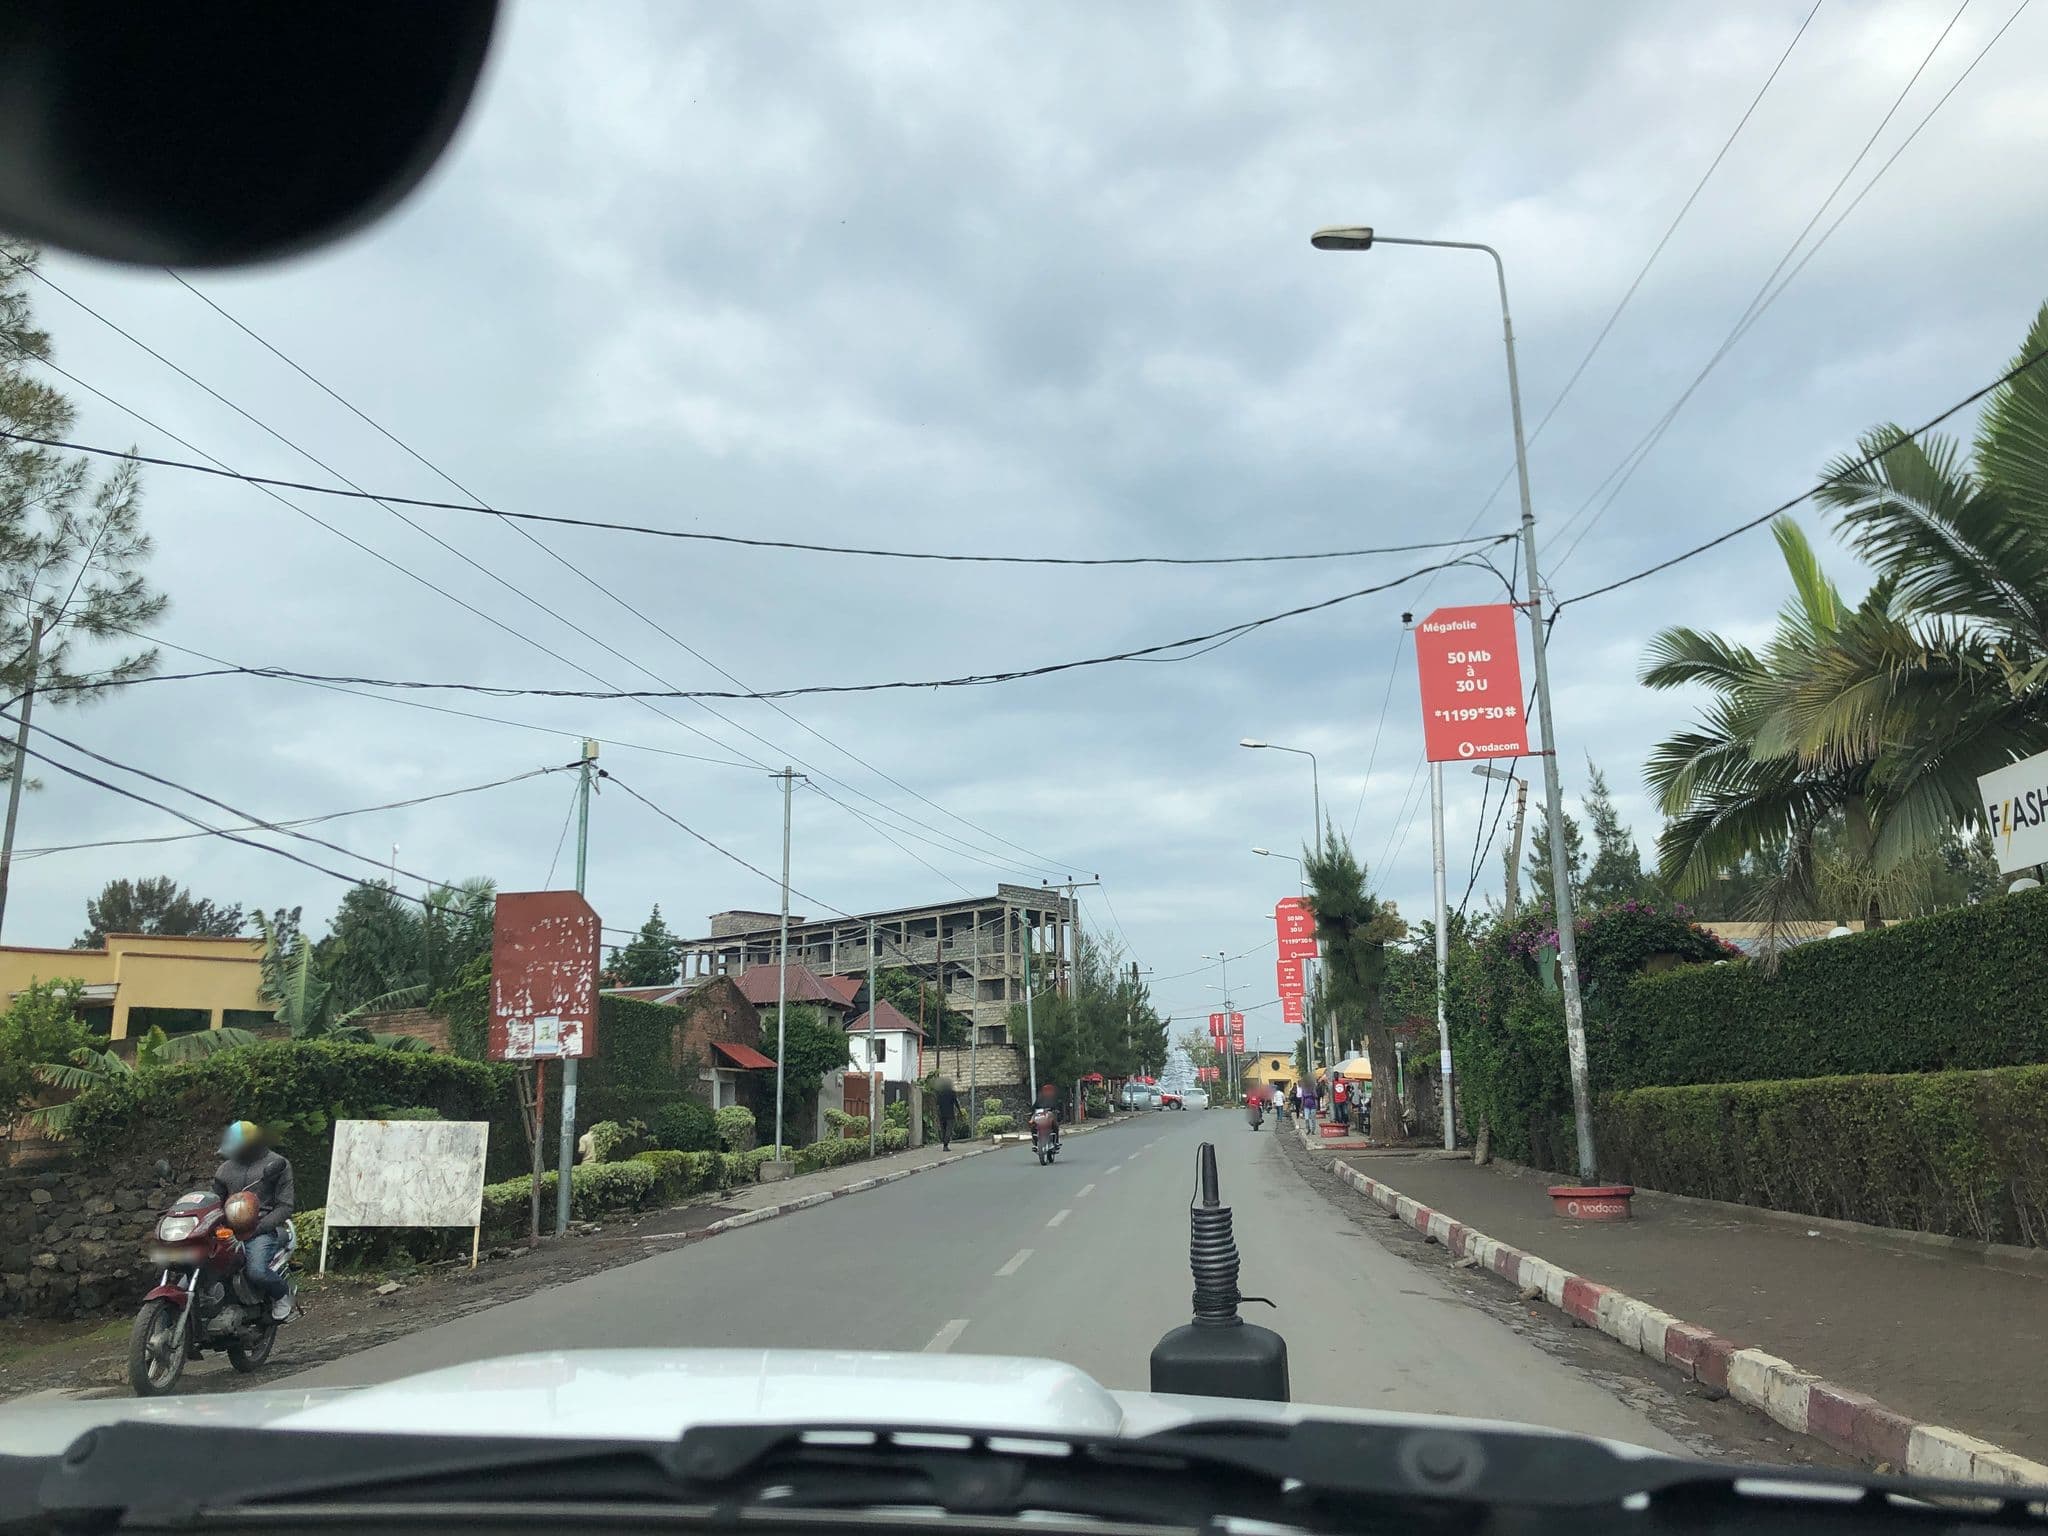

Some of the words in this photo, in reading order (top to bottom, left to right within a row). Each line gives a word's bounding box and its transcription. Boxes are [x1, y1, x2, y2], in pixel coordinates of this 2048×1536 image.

[1423, 620, 1477, 633] Mégafolie
[1447, 652, 1466, 664] 50
[1468, 650, 1491, 663] Mb
[1466, 664, 1475, 677] à
[1456, 680, 1475, 692] 30
[1476, 679, 1488, 691] U
[1475, 743, 1519, 752] vodacom
